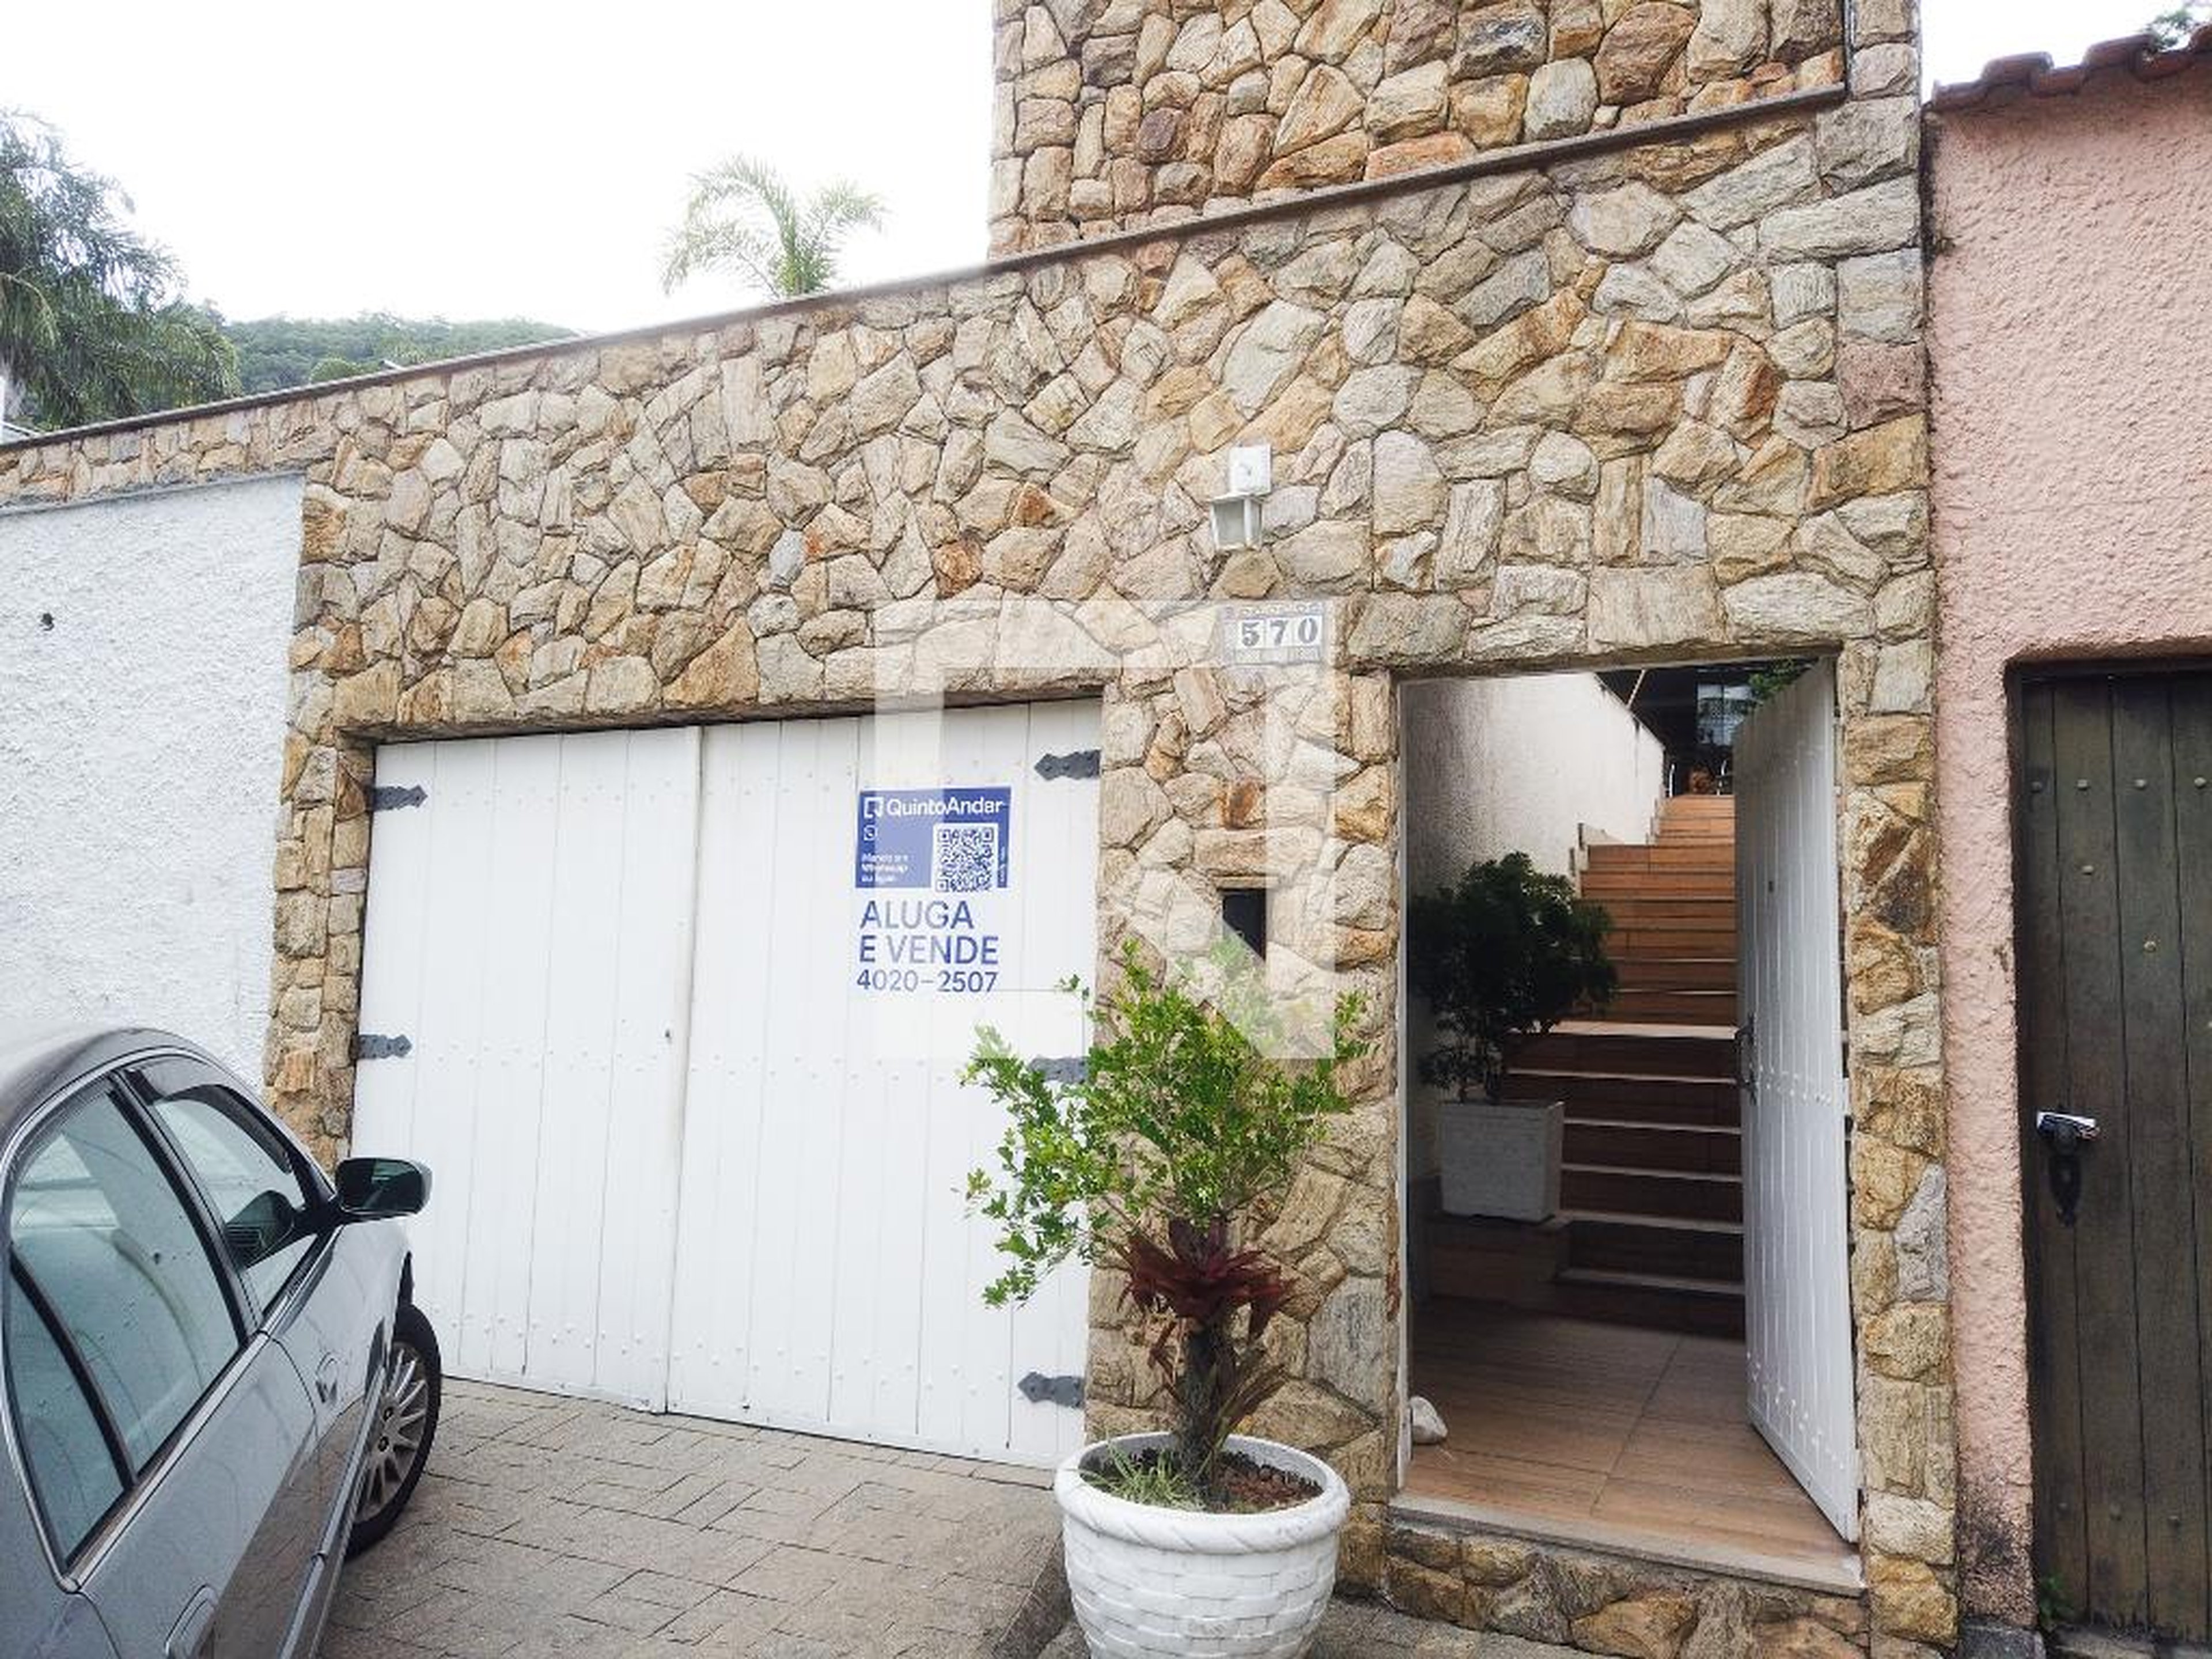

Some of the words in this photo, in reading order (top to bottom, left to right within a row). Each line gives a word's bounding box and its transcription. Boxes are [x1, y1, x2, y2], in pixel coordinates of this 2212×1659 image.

[1241, 617, 1319, 646] 570
[887, 797, 1003, 817] QuintoAndar
[859, 900, 974, 929] ALUGA
[859, 934, 876, 963] E
[886, 934, 999, 965] VENDE
[856, 968, 998, 993] 4020-2507
